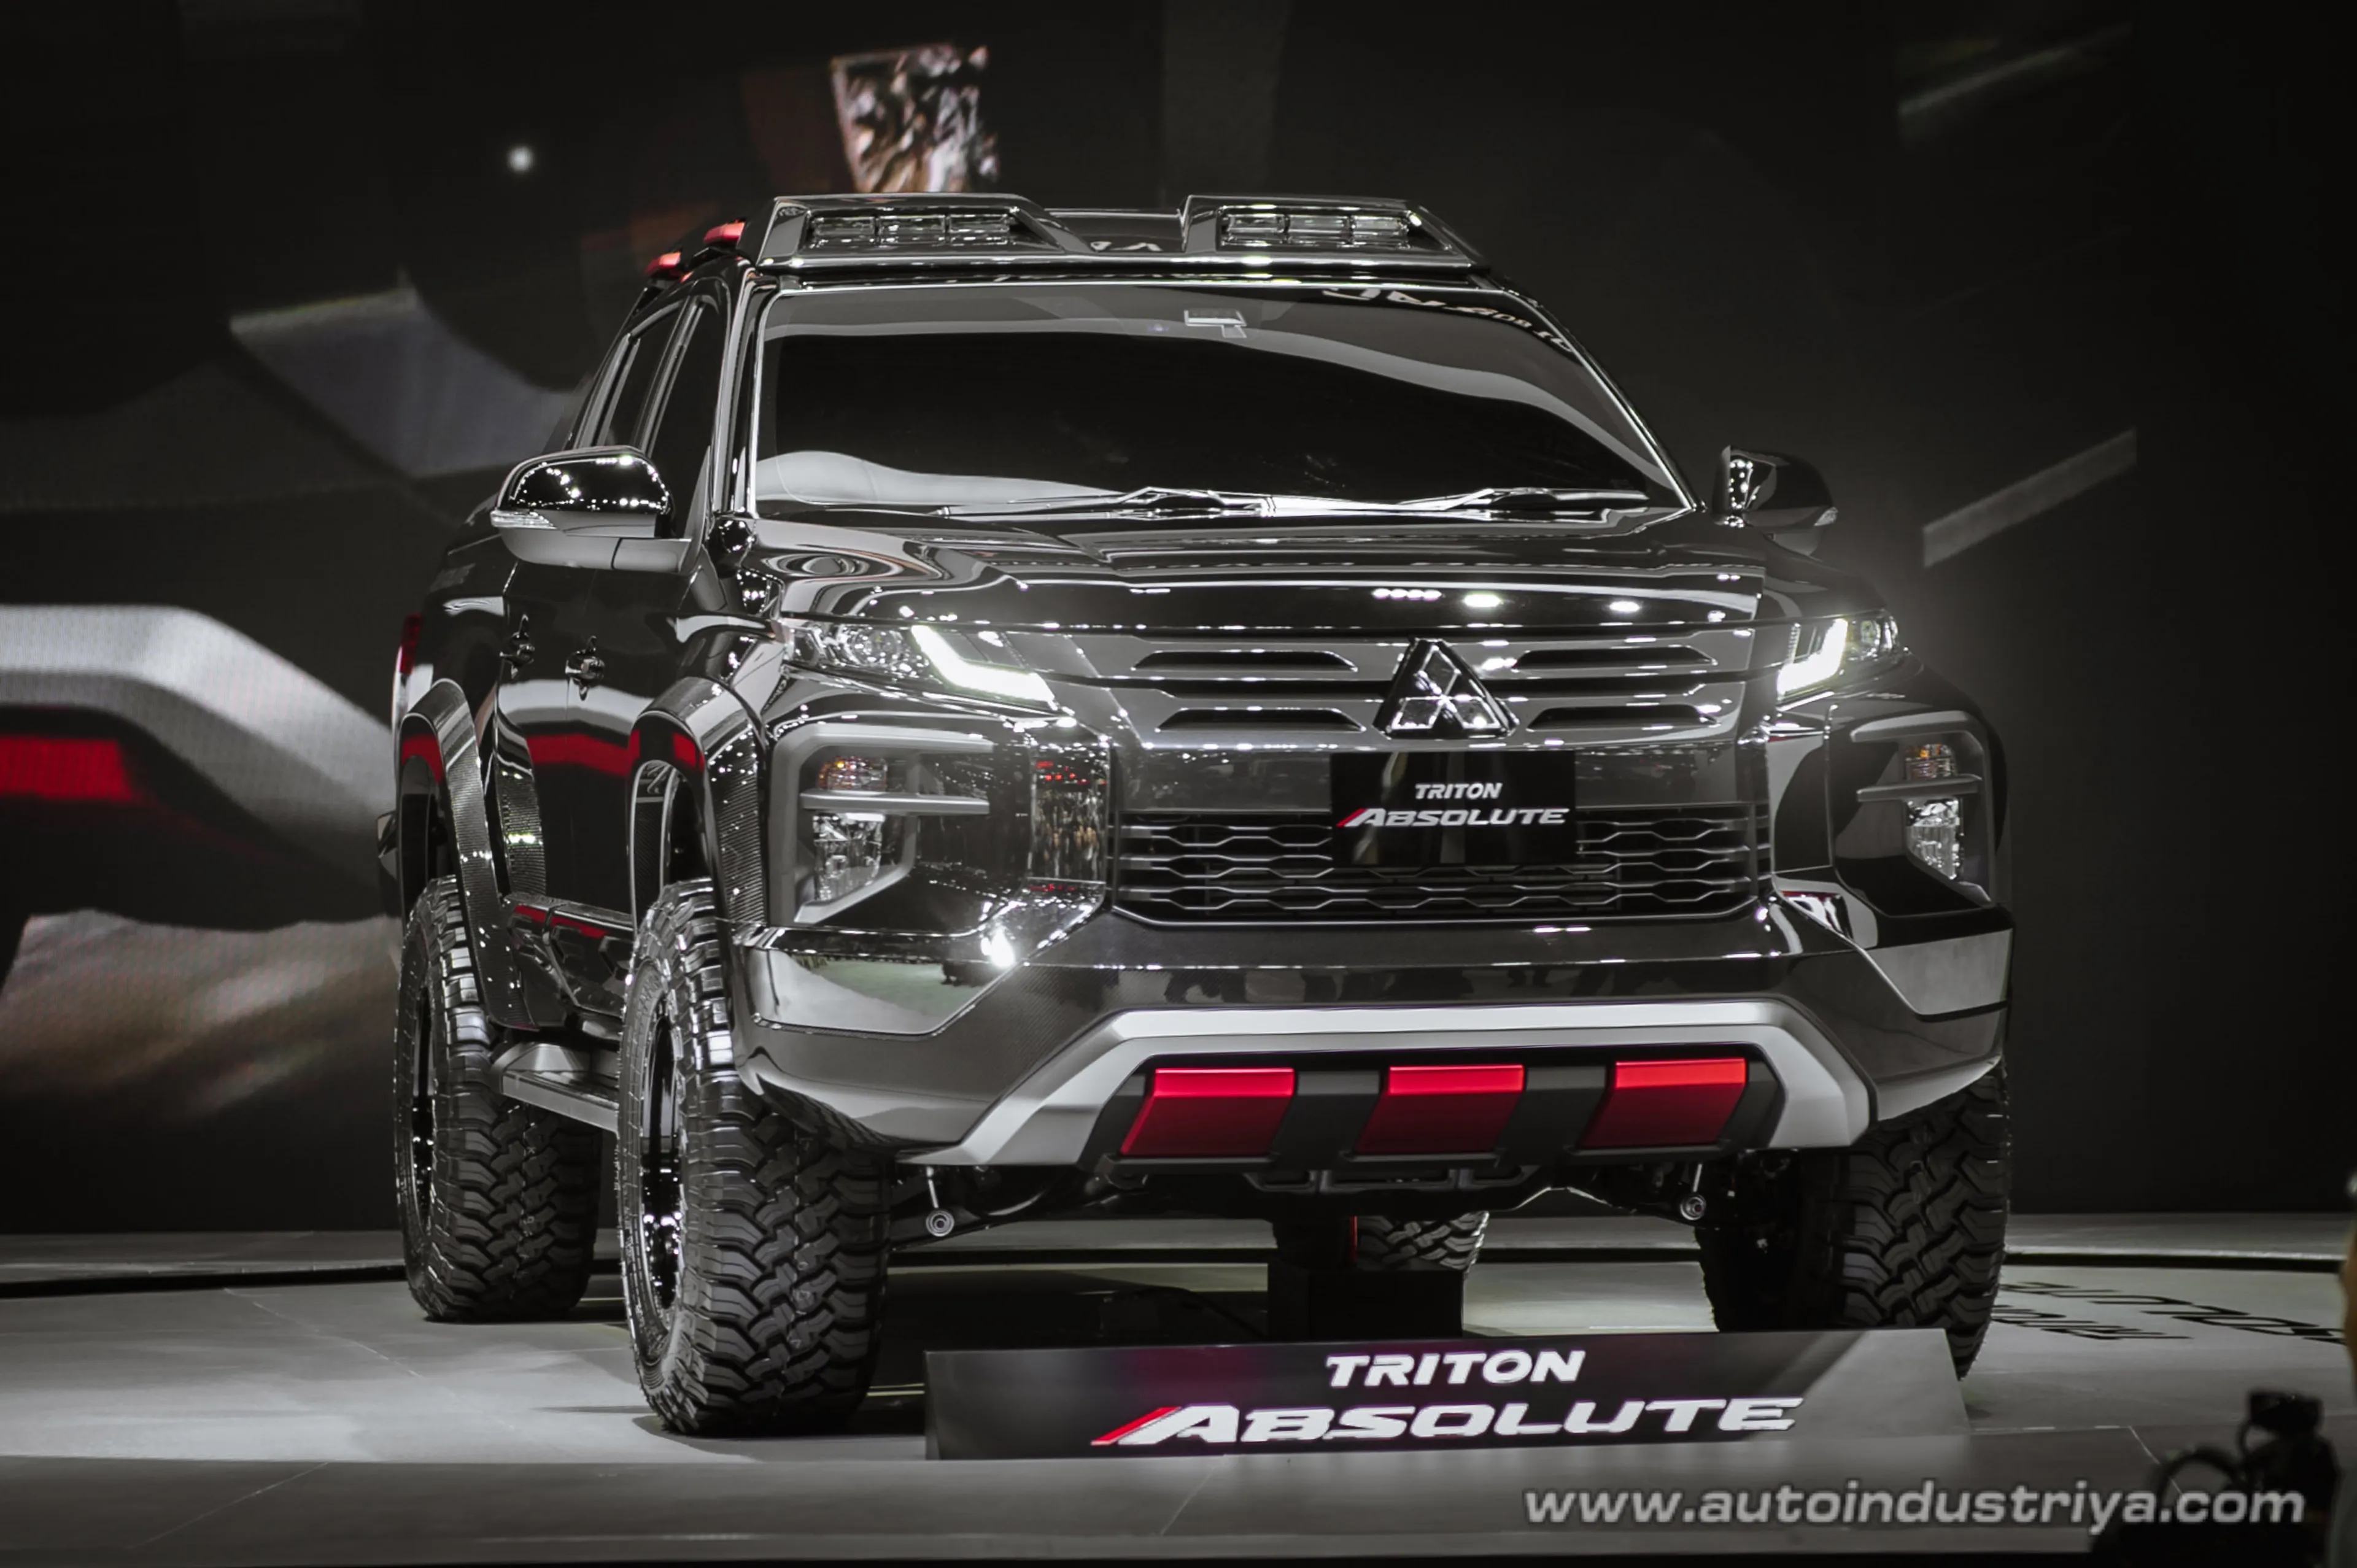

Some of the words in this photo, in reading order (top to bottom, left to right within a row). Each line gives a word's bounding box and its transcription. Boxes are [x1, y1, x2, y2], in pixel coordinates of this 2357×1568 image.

[1415, 782, 1503, 800] TRITON
[1336, 808, 1570, 828] ABSOLUTE
[1326, 1349, 1586, 1388] TRITON
[1091, 1396, 1804, 1446] ABSOLUTE
